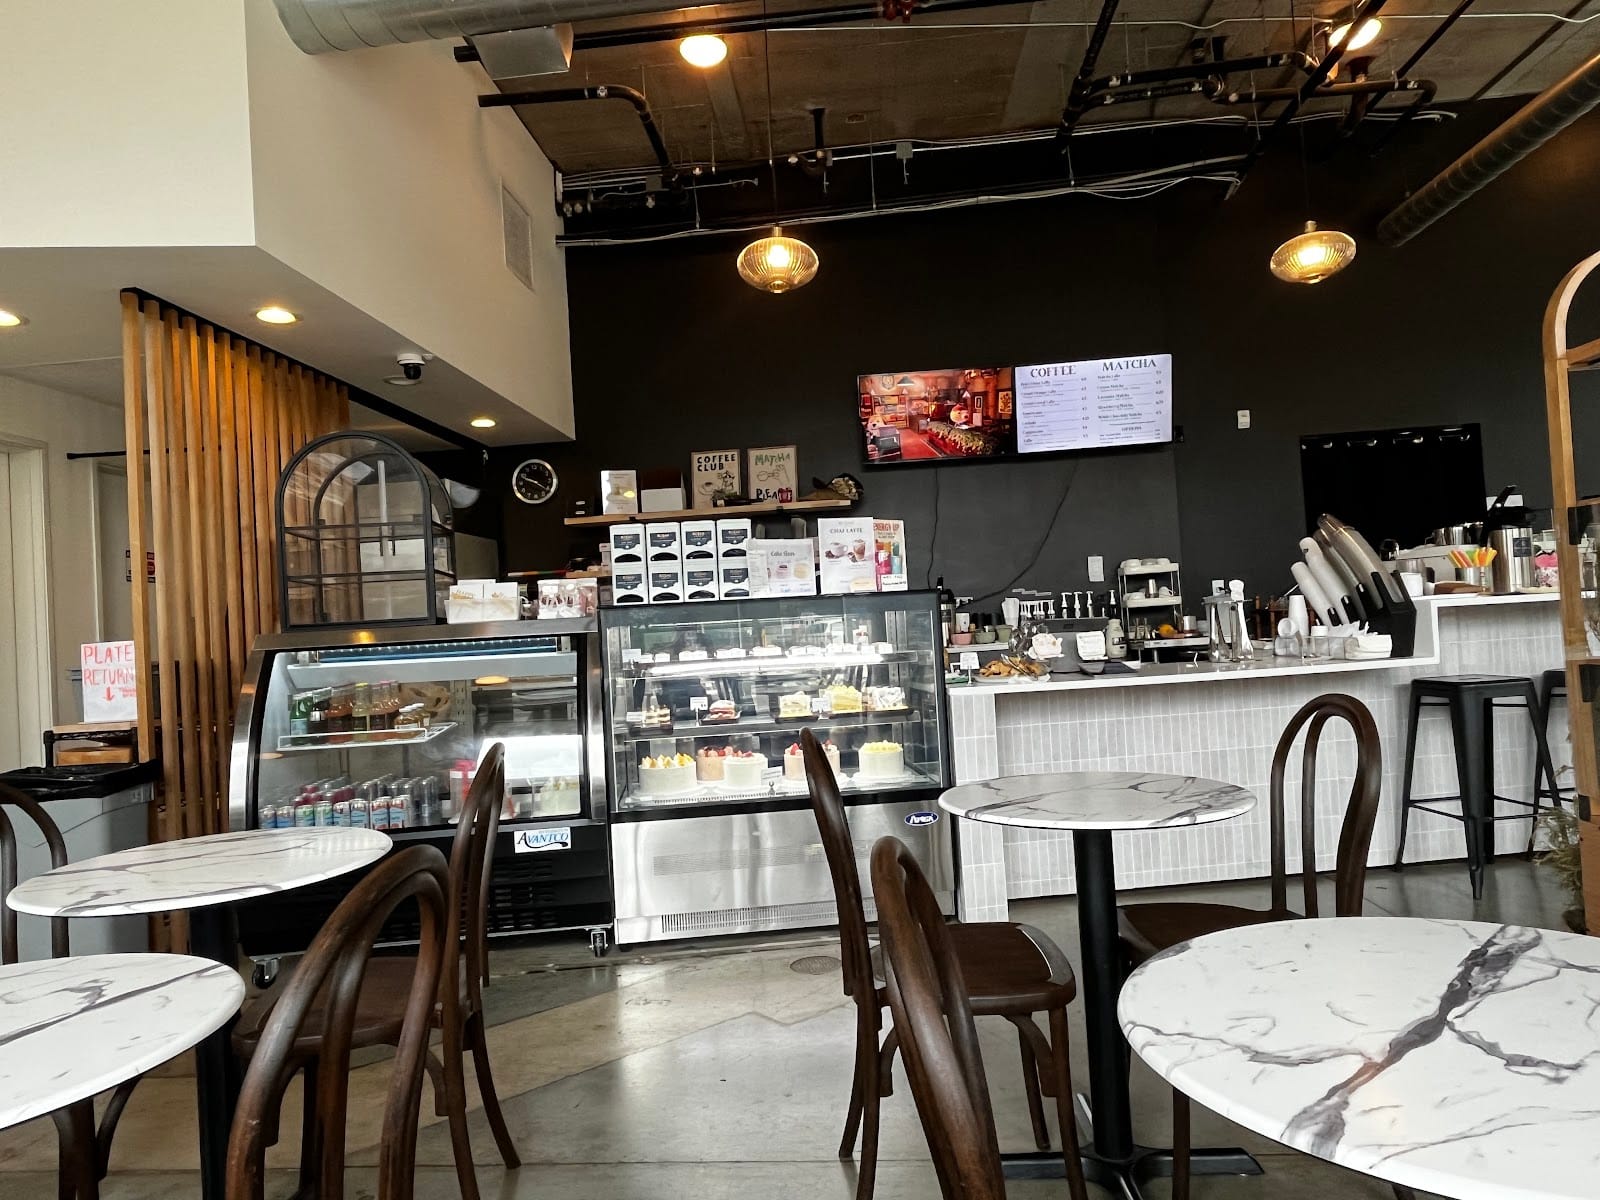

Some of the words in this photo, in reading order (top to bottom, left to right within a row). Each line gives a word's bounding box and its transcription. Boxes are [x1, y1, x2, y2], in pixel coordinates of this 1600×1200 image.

[1030, 365, 1077, 378] COFFEE
[1102, 358, 1157, 372] MATCHA
[697, 453, 736, 465] COFFEE
[755, 453, 791, 466] MATCHA
[697, 462, 725, 472] CLUB
[83, 643, 133, 665] PLATE
[83, 667, 135, 688] RETURN
[516, 831, 569, 849] AVANTCO
